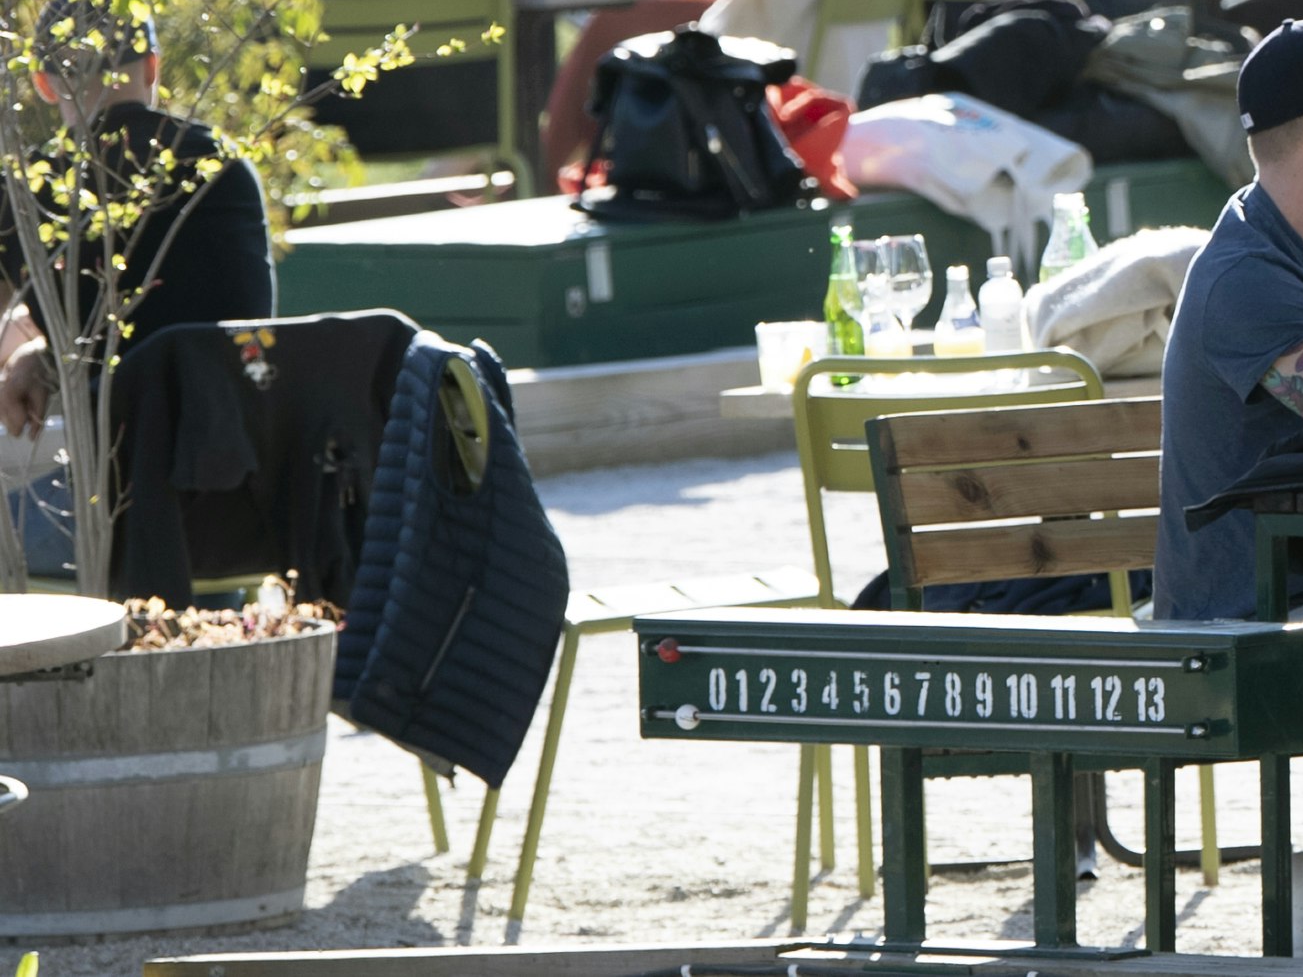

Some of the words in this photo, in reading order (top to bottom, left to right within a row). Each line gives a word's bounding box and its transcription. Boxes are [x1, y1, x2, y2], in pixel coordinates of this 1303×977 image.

[709, 668, 726, 711] 0
[735, 669, 748, 712] 1
[759, 668, 777, 713] 2
[791, 669, 807, 713] 3
[821, 671, 839, 710] 4
[853, 671, 869, 714] 5
[884, 671, 901, 715] 6
[915, 672, 931, 716] 7
[945, 672, 962, 717] 8
[975, 672, 993, 718] 9
[1006, 673, 1037, 719] 10
[1050, 674, 1076, 719] 11
[1090, 675, 1122, 721] 12
[1133, 676, 1165, 722] 13
